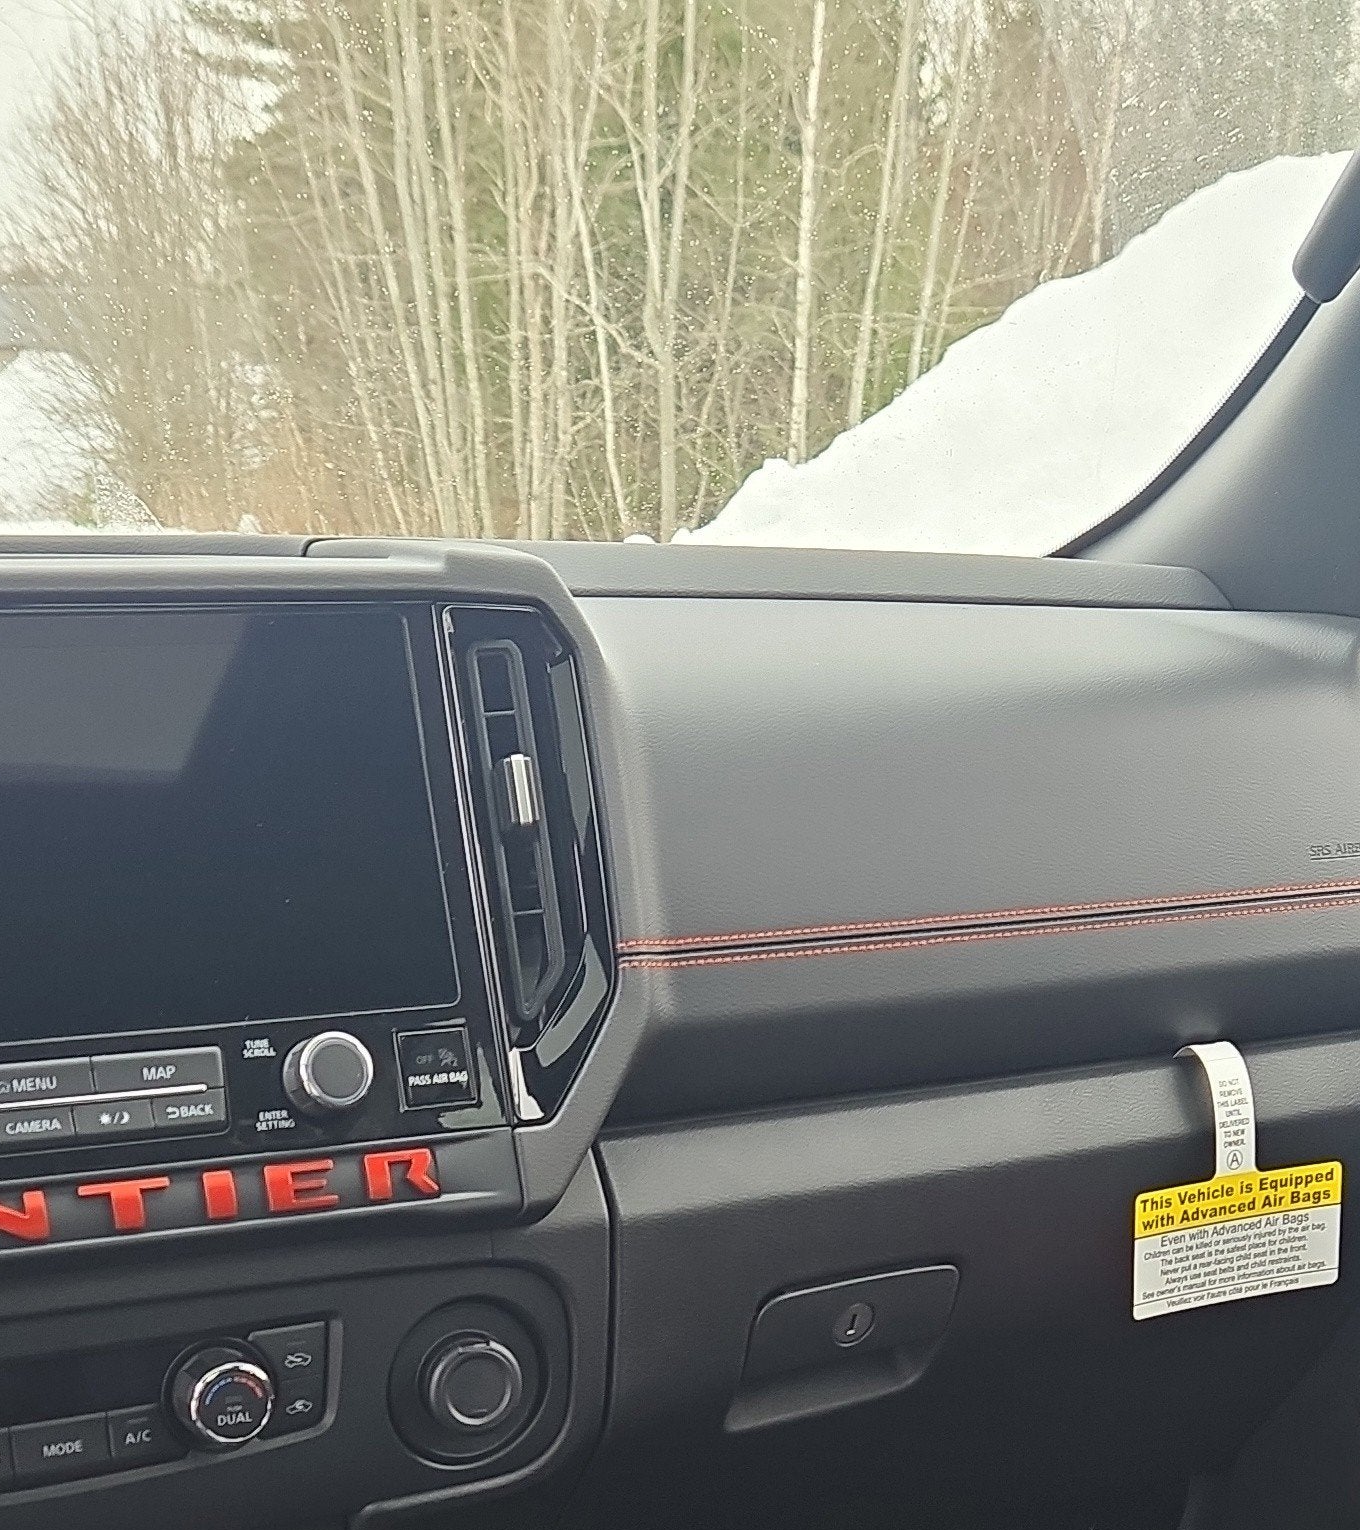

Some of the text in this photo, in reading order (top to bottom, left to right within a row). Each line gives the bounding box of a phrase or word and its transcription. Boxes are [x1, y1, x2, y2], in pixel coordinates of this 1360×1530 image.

[242, 1048, 276, 1059] SCROLL
[142, 1065, 176, 1081] MAP
[408, 1071, 469, 1087] PASS AIR BAG
[12, 1076, 57, 1092] MENU
[180, 1104, 214, 1118] BACK
[259, 1110, 289, 1122] ENTER
[5, 1118, 62, 1135] CAMERA
[1140, 1168, 1334, 1213] This Vehicle is Equipped
[1142, 1189, 1331, 1231] with Advanced Air Bags
[1160, 1213, 1309, 1248] Even with Advanced Air Bags
[217, 1411, 253, 1427] DUAL
[125, 1429, 152, 1445] A/C
[42, 1440, 83, 1458] MODE
